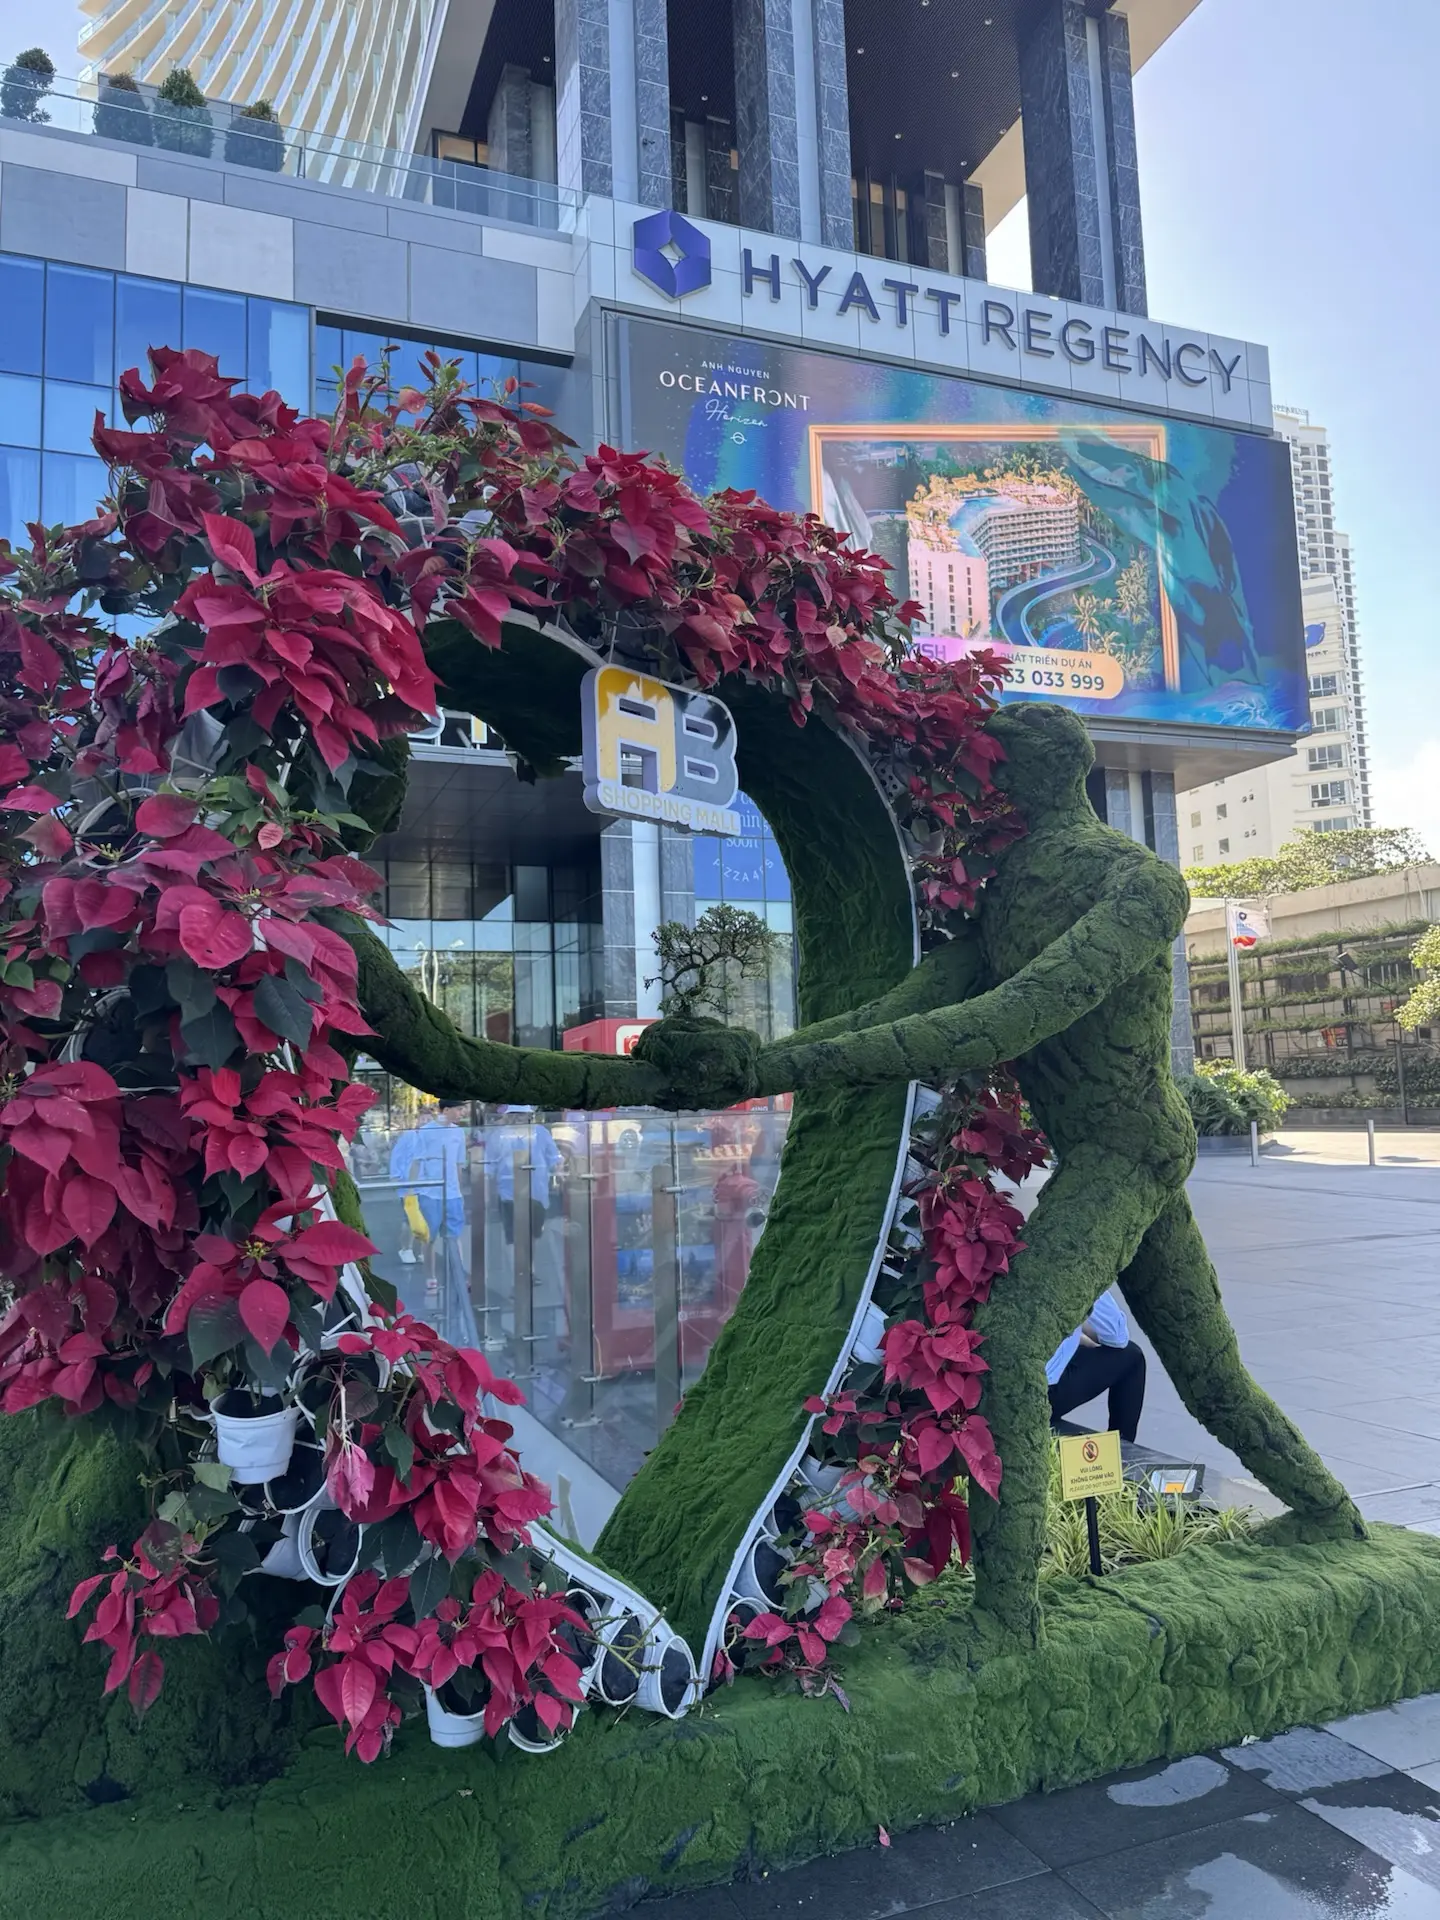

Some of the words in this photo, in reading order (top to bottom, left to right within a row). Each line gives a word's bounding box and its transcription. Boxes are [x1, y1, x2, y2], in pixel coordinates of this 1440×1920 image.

[743, 248, 961, 337] HYATT
[982, 299, 1242, 394] REGENCY
[701, 360, 723, 371] ANH
[727, 364, 770, 380] NGUYEN
[1002, 667, 1025, 684] 63
[1031, 670, 1065, 688] 033
[1071, 674, 1105, 691] 999
[1061, 657, 1076, 670] DỰ
[1079, 655, 1092, 669] ÁN
[594, 664, 739, 809] AB
[601, 785, 691, 822] SHOPPING
[695, 807, 740, 832] MALL
